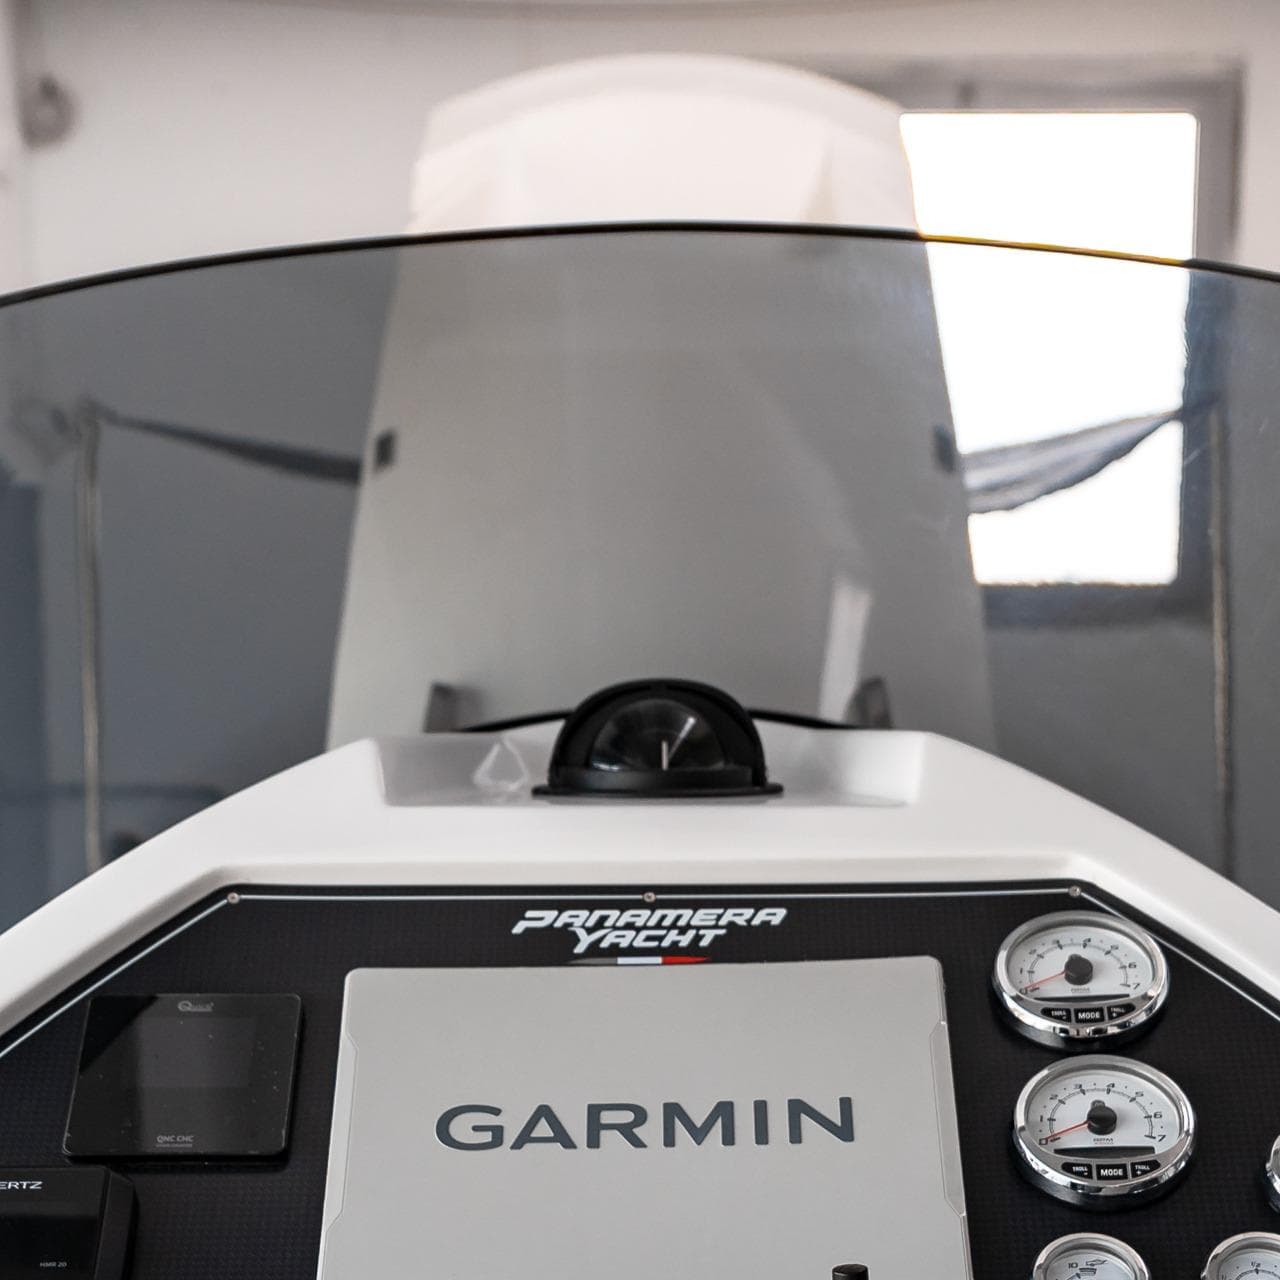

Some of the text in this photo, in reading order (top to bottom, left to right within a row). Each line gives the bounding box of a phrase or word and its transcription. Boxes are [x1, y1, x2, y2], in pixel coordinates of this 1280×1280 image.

[511, 908, 788, 934] PANAMERA
[568, 928, 727, 953] YACHT
[1078, 1011, 1101, 1020] MODE
[434, 1096, 856, 1151] GARMIN
[1100, 1168, 1123, 1176] MODE
